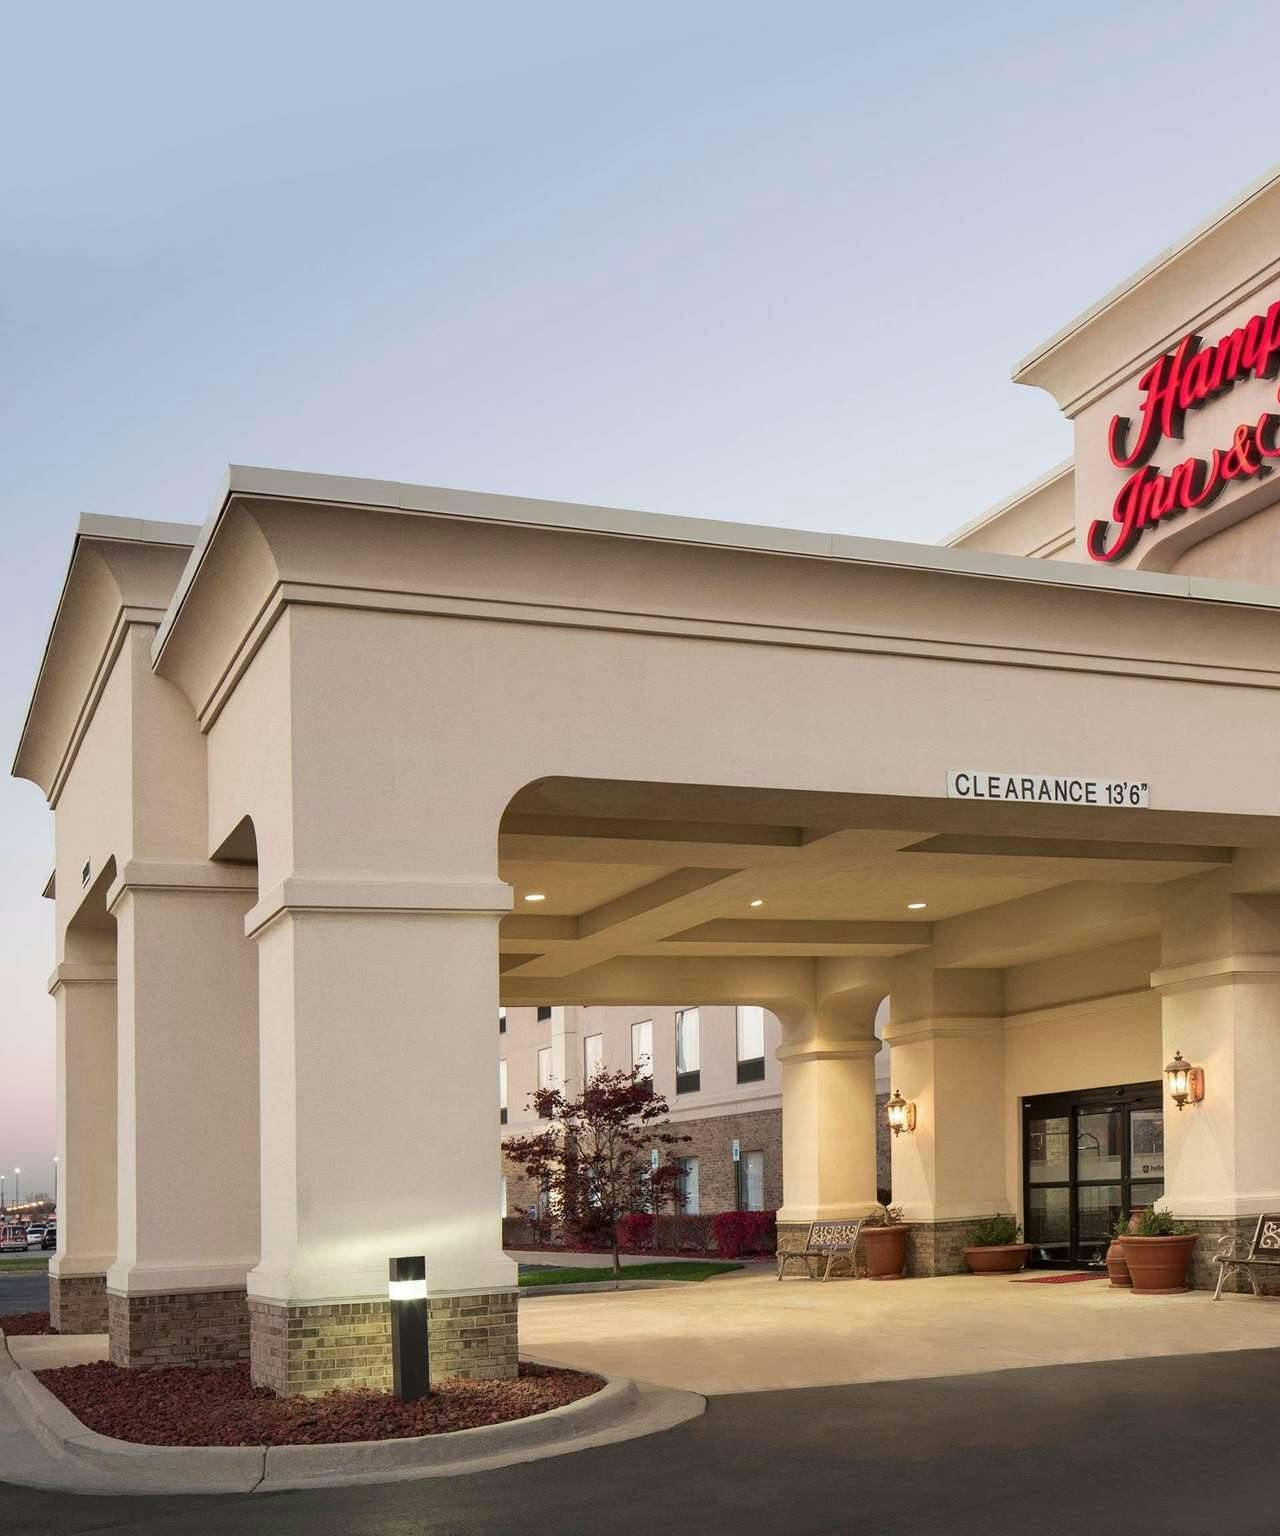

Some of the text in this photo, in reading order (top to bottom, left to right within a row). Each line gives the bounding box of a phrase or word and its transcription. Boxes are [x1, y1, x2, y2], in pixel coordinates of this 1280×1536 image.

[1087, 448, 1230, 562] Inn
[1221, 424, 1262, 479] &
[955, 773, 1097, 803] CLEARANCE
